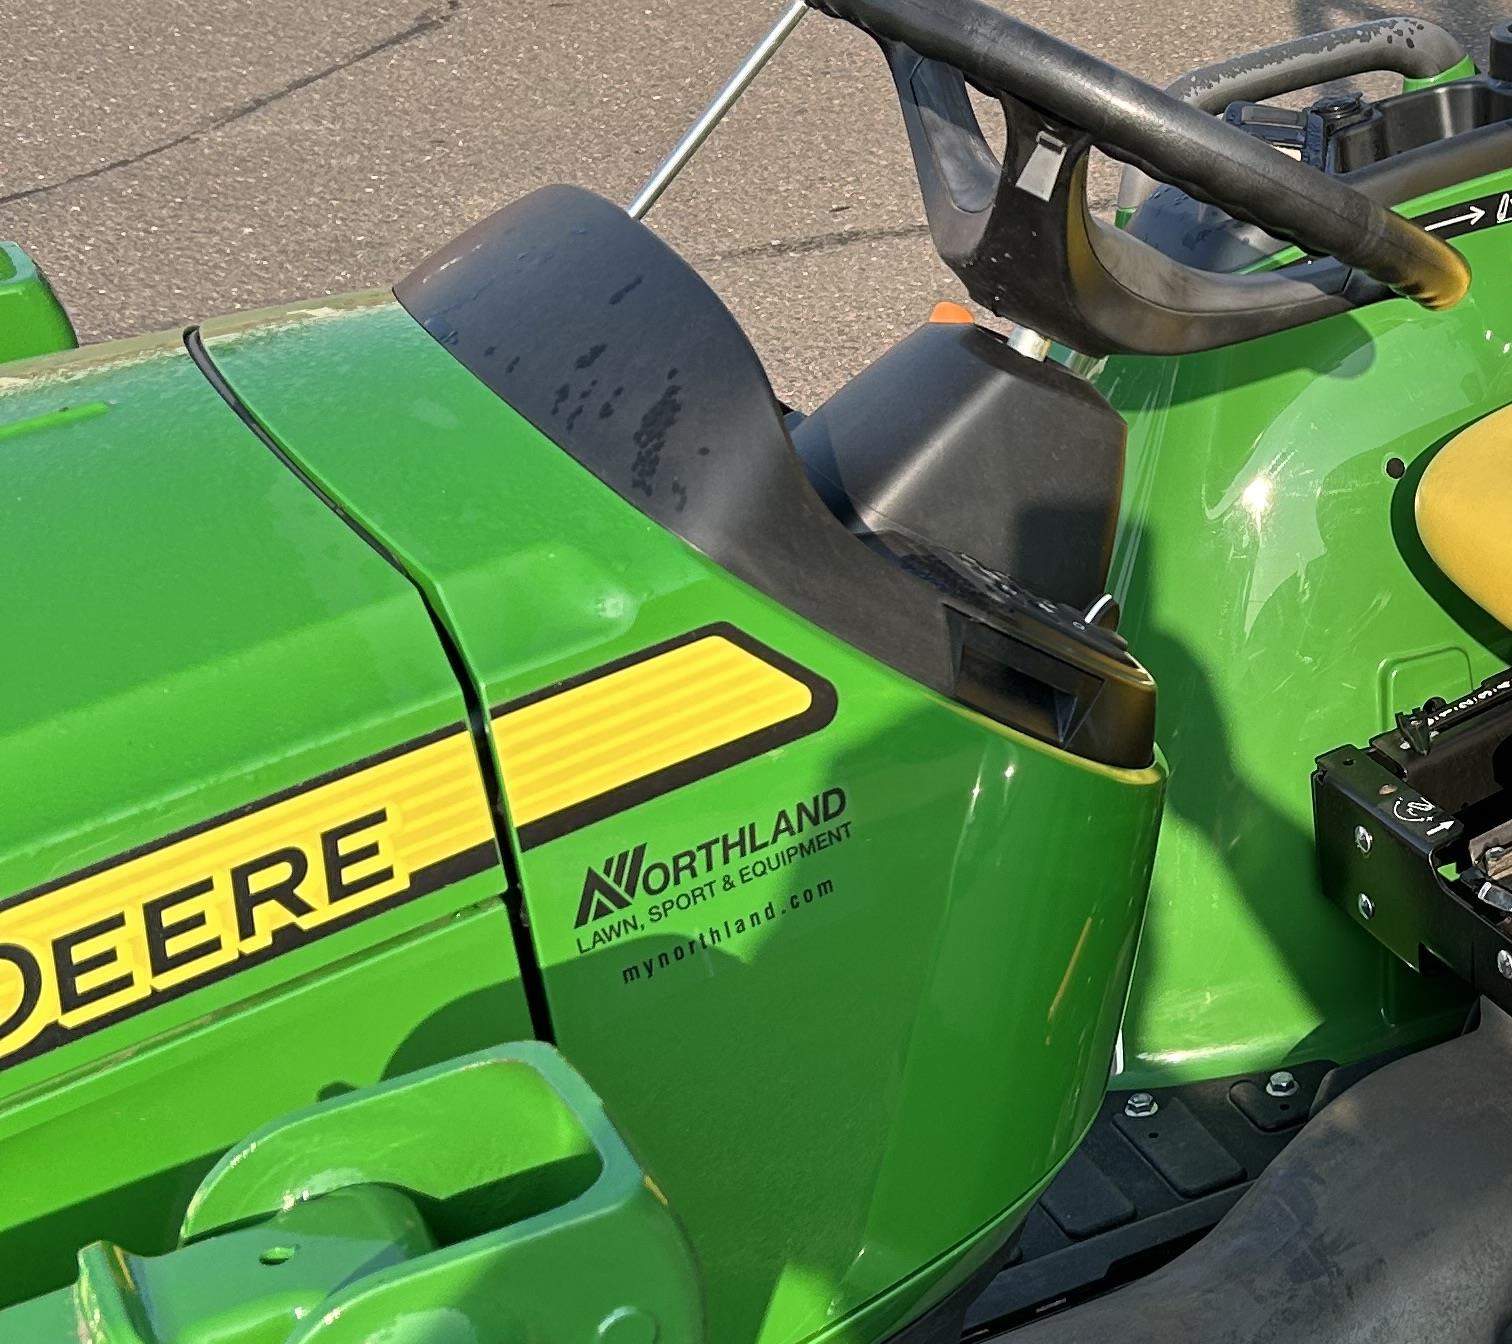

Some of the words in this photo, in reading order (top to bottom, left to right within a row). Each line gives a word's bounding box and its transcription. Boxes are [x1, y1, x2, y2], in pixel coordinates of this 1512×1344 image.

[574, 787, 847, 929] NORTHLAND
[576, 915, 645, 954] LAWN,
[648, 879, 717, 923] SPORT
[722, 874, 736, 892] &
[740, 821, 852, 884] EQUIPMENT
[621, 879, 834, 984] mynorthland.com
